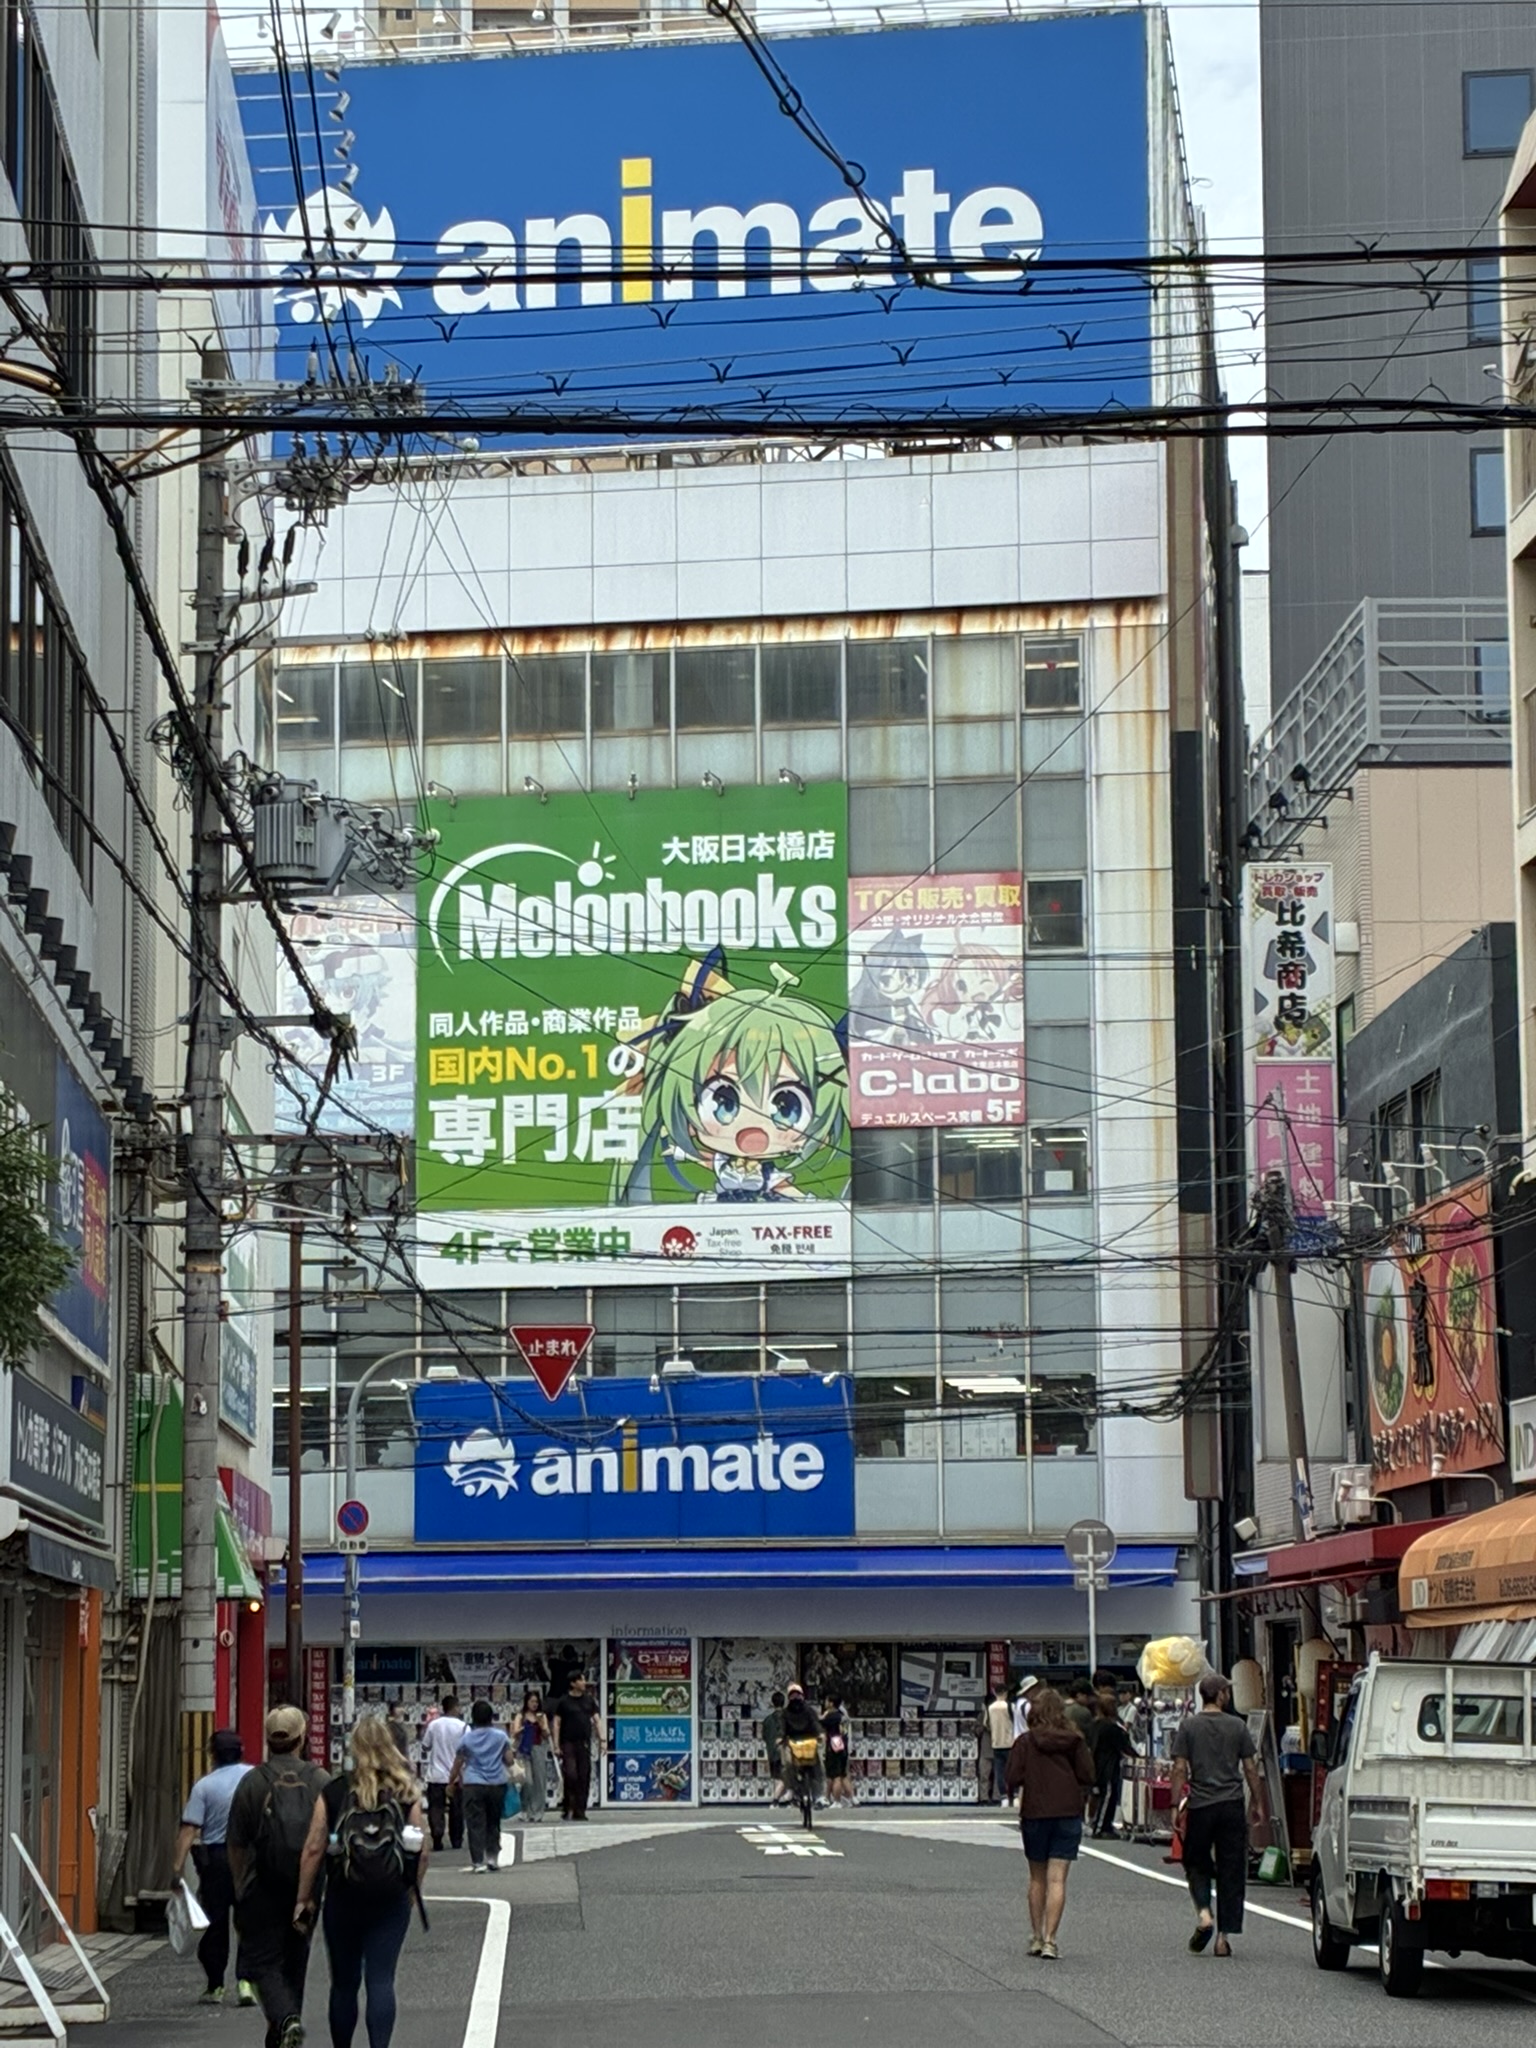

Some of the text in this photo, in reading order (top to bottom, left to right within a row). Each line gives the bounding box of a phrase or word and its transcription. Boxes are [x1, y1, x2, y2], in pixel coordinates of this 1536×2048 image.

[432, 157, 1045, 316] animate
[661, 830, 836, 866] 大阪日本橋店
[458, 872, 838, 960] Melonbooks
[1275, 899, 1309, 1026] 比希商店
[429, 1005, 643, 1039] 同人作品・商業作品
[371, 1064, 405, 1082] 3F
[429, 1042, 645, 1085] 国内No.1の
[859, 1068, 1021, 1098] C-labo
[986, 1099, 1023, 1123] 5F
[428, 1093, 645, 1166] 専門店
[439, 1226, 632, 1266] 4Fで営業中
[751, 1225, 833, 1241] TAX-FREE
[527, 1338, 578, 1358] 止まれ
[531, 1421, 825, 1496] animate
[611, 1624, 688, 1637] information
